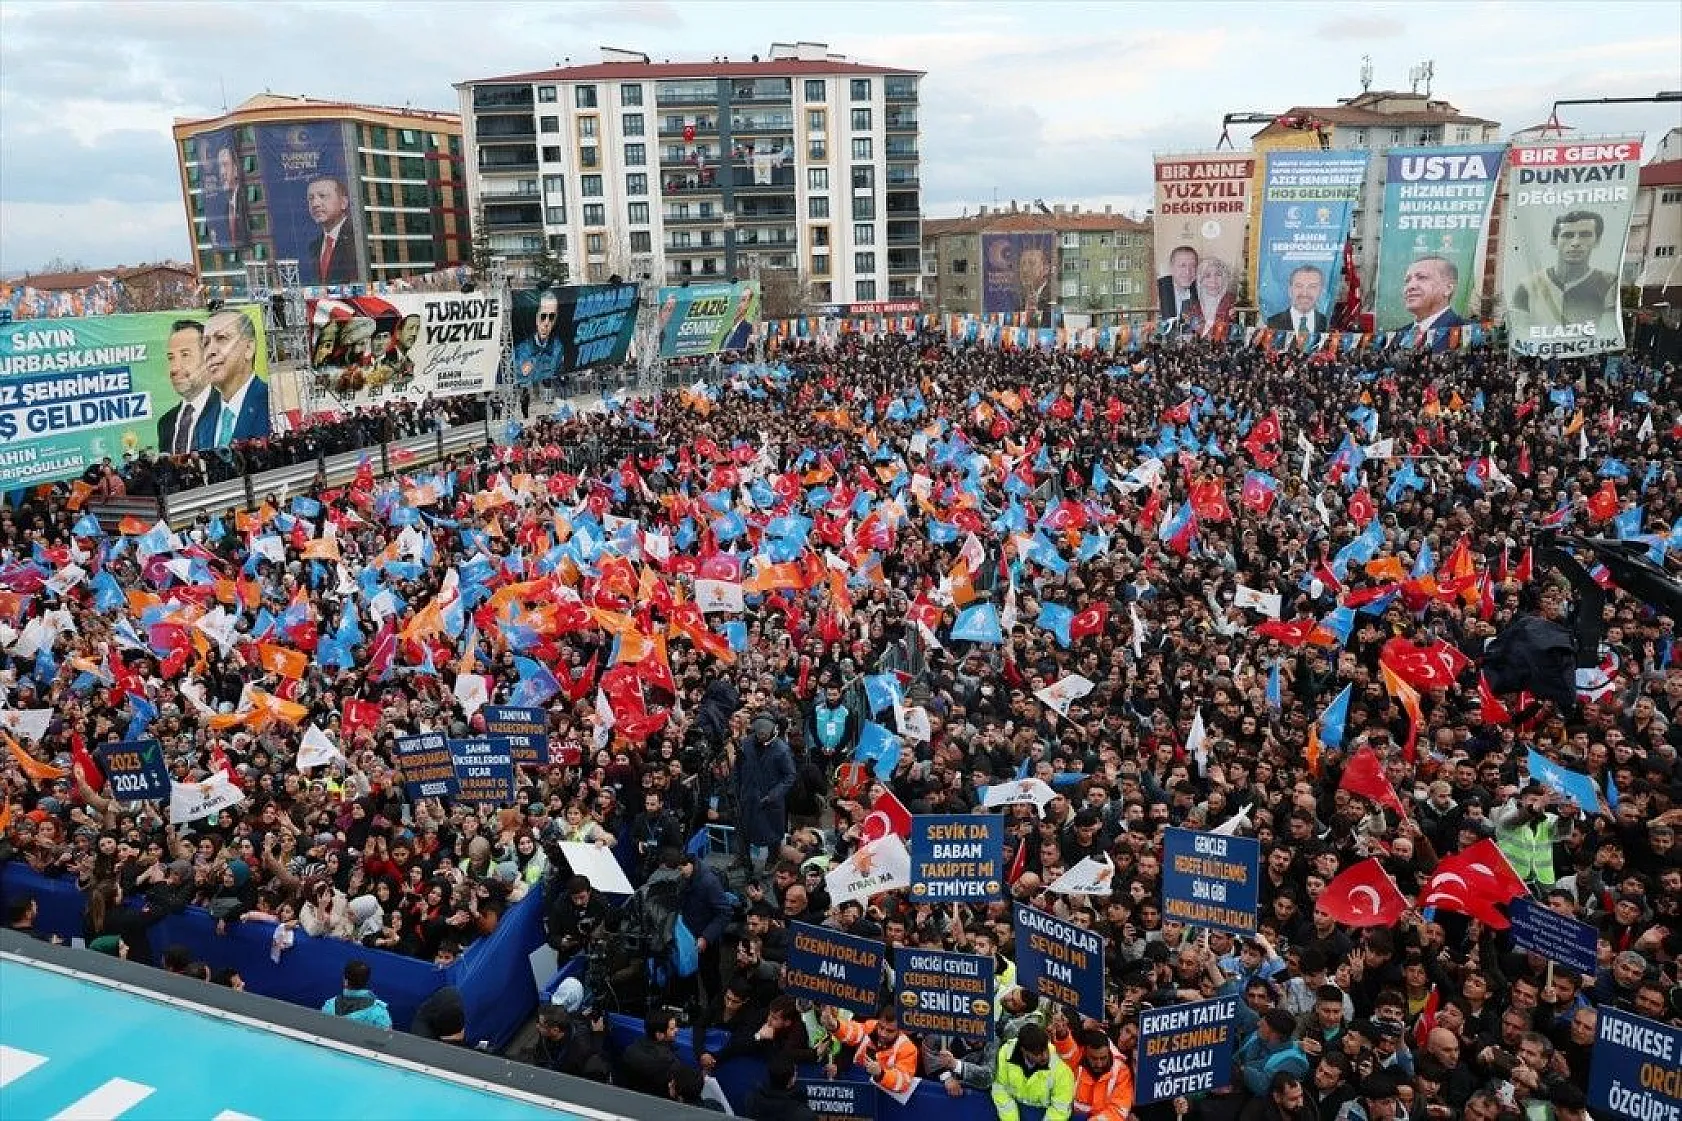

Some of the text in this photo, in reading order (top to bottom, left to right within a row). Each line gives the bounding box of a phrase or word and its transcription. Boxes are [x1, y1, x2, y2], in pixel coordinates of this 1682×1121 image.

[1520, 144, 1632, 163] BİR GENÇ
[1162, 162, 1247, 179] BİR ANNE
[1401, 155, 1488, 180] USTA
[1519, 163, 1626, 185] DÜNYAYI
[1164, 182, 1244, 198] YÜZYILI
[1271, 189, 1296, 199] HOŞ
[1400, 182, 1487, 198] HİZMETTE
[1517, 186, 1629, 208] DEĞİŞTİRİR
[1162, 201, 1244, 216] DEĞİŞTİRİR
[1399, 200, 1485, 213] MUHALEFET
[1399, 215, 1482, 230] STRESTE
[424, 299, 499, 323] TÜRKİYE
[425, 322, 494, 344] YÜZYILI
[1529, 321, 1597, 338] ELAZIĞ
[12, 330, 76, 351] SAYIN
[1538, 338, 1619, 357] GENÇLİK
[22, 371, 130, 405] ŞEHRİMİZE
[27, 394, 148, 433] GELDİNİZ
[114, 774, 148, 792] 2024
[927, 822, 988, 840] SEVİK DA
[933, 845, 982, 859] BABAM
[920, 860, 994, 878] TAKİPTE Mİ
[927, 879, 985, 897] ETMİYEK
[1019, 908, 1098, 955] GAKGOŞLAR
[795, 932, 877, 968] ÖZENİYORLAR
[819, 960, 846, 980] AMA
[944, 958, 978, 976] CEVİZLİ
[1045, 959, 1072, 984] TAM
[920, 989, 970, 1014] SENİ DE
[1037, 976, 1080, 1006] SEVER
[903, 1011, 954, 1032] CİĞERDEN
[1142, 1001, 1236, 1035] EKREM TATİLE
[1147, 1025, 1228, 1056] BİZ SENİNLE
[1600, 1015, 1675, 1061] HERKESE
[1157, 1049, 1214, 1076] SALÇALI
[1153, 1072, 1214, 1099] KÖFTEYE
[1609, 1080, 1680, 1121] ÖZGÜR'E
